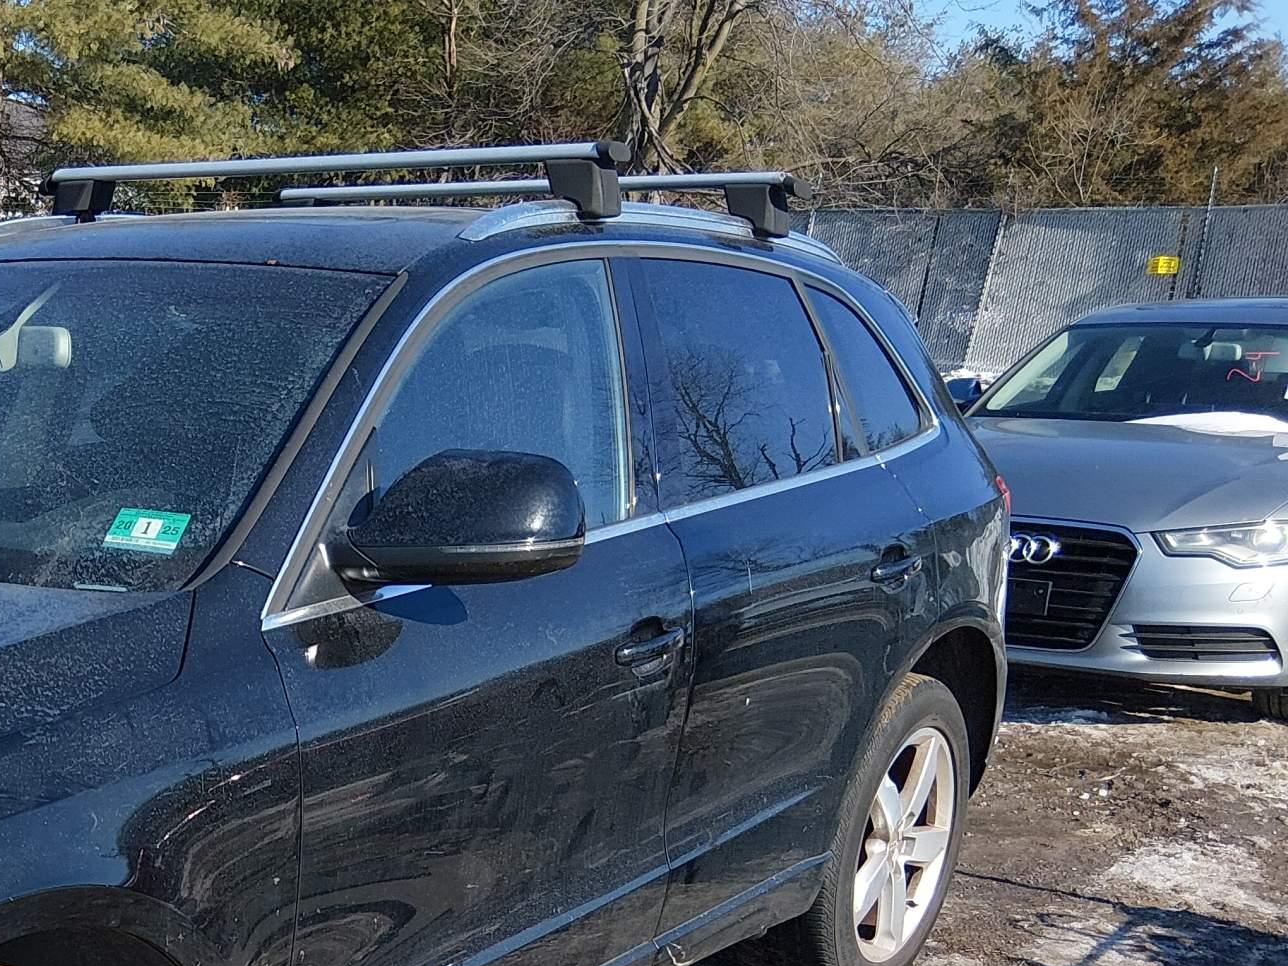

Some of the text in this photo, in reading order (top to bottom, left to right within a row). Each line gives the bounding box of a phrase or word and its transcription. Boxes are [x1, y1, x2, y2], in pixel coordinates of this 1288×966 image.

[115, 520, 181, 536] 20 1 25
